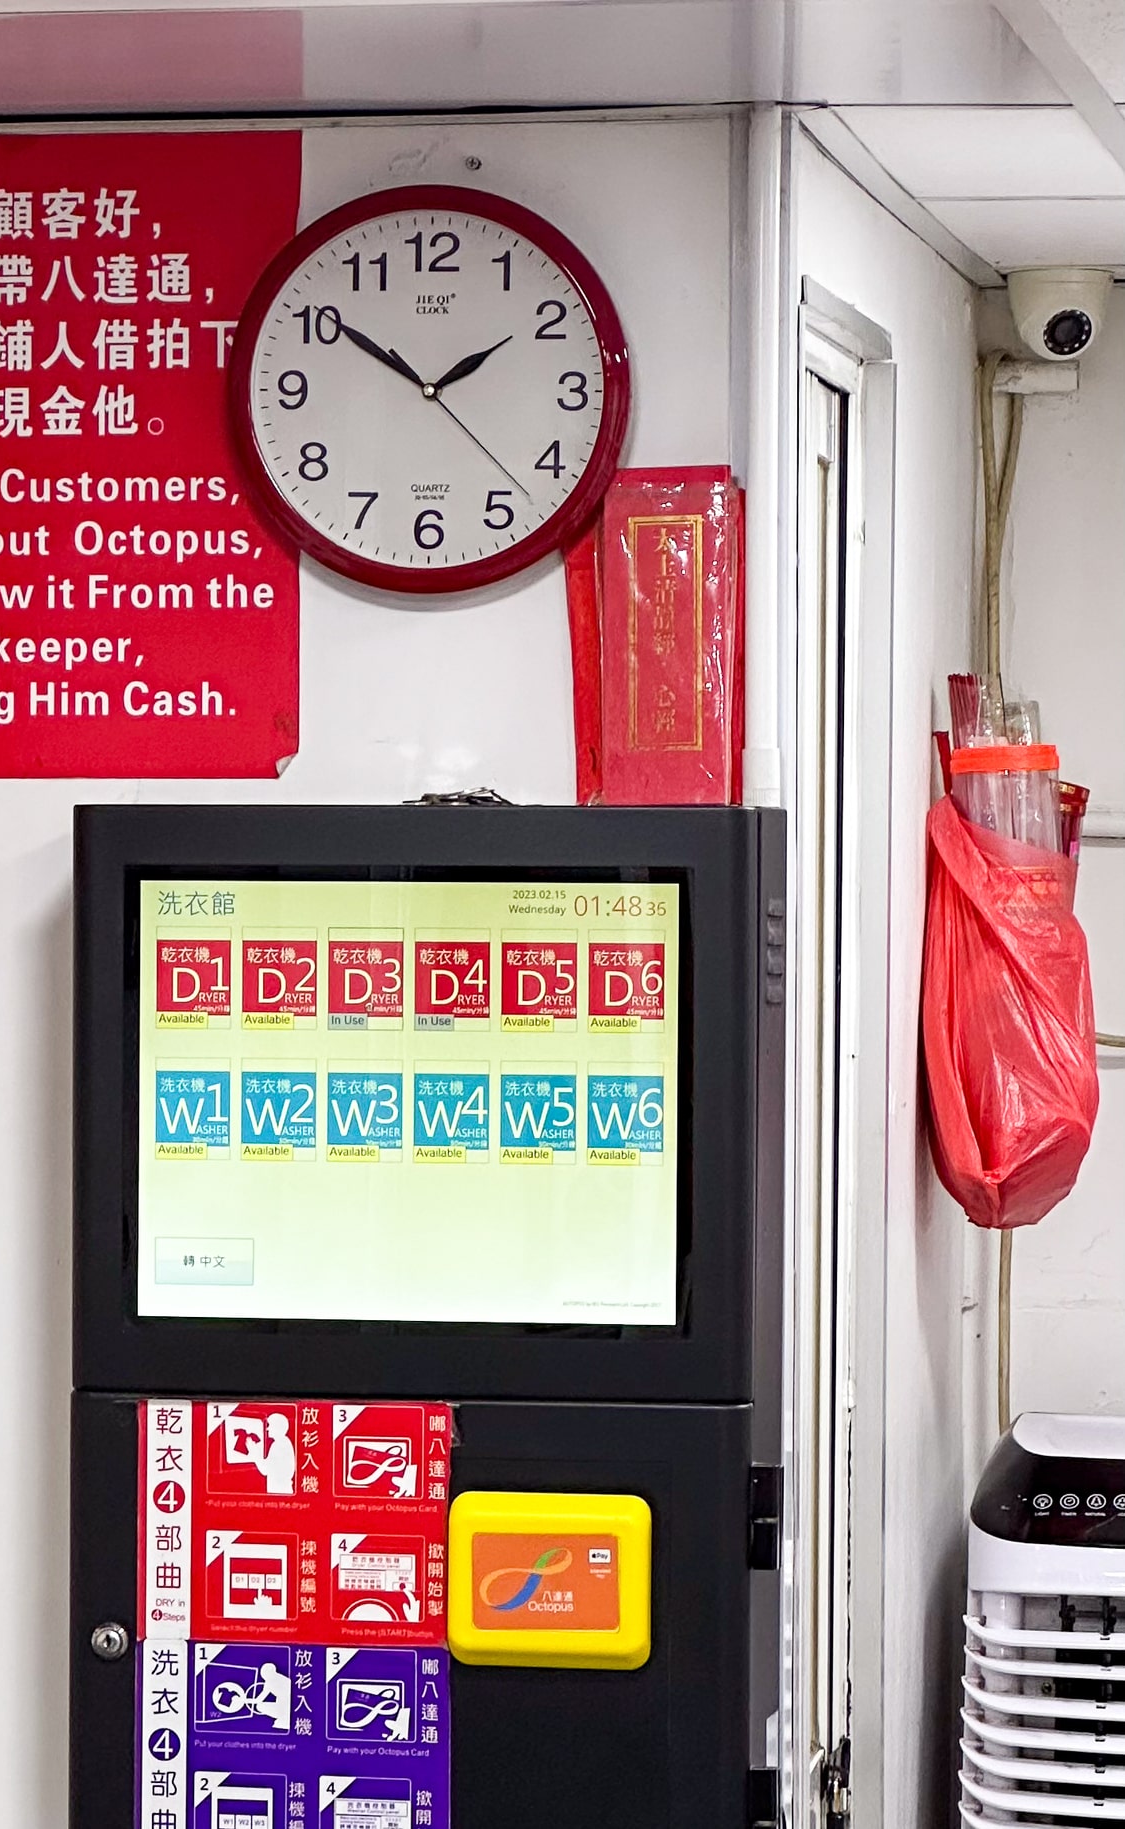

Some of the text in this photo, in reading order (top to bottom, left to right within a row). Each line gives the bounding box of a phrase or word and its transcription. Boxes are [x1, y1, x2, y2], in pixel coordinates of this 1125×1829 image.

[404, 231, 460, 272] 12
[342, 252, 387, 291] 11
[491, 251, 511, 291] 1
[416, 294, 435, 304] JIE
[416, 306, 449, 314] CLOCK
[292, 305, 341, 344] 10
[535, 300, 567, 339] 2
[277, 370, 308, 409] 9
[557, 371, 588, 410] 3
[298, 442, 328, 481] 8
[534, 440, 566, 478] 4
[0, 468, 239, 505] Customers,
[410, 484, 451, 493] QUARTZ
[348, 492, 379, 529] 7
[483, 491, 514, 529] 5
[414, 510, 444, 549] 6
[74, 521, 262, 562] Octopus,
[47, 575, 74, 609] it
[89, 575, 194, 608] From
[207, 574, 274, 608] the
[30, 682, 109, 716] Him
[123, 681, 236, 716] Cash.
[513, 890, 566, 899] 2023.02.15
[158, 890, 235, 916] 洗衣館
[509, 895, 667, 917] Wednesday 01:48 36
[161, 947, 210, 963] 乾衣機
[247, 947, 296, 964] 乾衣機
[333, 948, 382, 965] 乾衣機
[420, 949, 469, 966] 乾衣機
[507, 950, 556, 966] 乾衣機
[594, 951, 643, 967] 乾衣機
[158, 1013, 205, 1024] Available
[244, 1014, 291, 1025] Available
[331, 1015, 365, 1025] In Use
[418, 1016, 451, 1026] In Use
[504, 1016, 550, 1027] Available
[591, 1018, 637, 1028] Available
[159, 1077, 205, 1094] 洗衣機
[246, 1078, 291, 1094] 洗衣機
[332, 1079, 377, 1095] 洗衣機
[419, 1080, 464, 1096] 洗衣機
[505, 1080, 551, 1097] 洗衣機
[592, 1081, 638, 1098] 洗衣機
[158, 1145, 204, 1155] Available
[244, 1146, 289, 1156] Available
[329, 1147, 376, 1157] Available
[416, 1148, 462, 1158] Available
[503, 1149, 549, 1159] Available
[590, 1150, 636, 1160] Available
[200, 1255, 225, 1268] 中文
[213, 1405, 221, 1418] 1
[339, 1409, 347, 1422] 3
[301, 1407, 319, 1494] 放衫入機
[351, 1503, 367, 1511] with
[386, 1503, 417, 1513] Octopus
[418, 1504, 438, 1513] Card
[212, 1536, 220, 1549] 2
[338, 1539, 348, 1551] 4
[156, 1598, 185, 1607] DRY in
[528, 1601, 574, 1613] Octopus
[199, 1647, 208, 1660] 1
[332, 1652, 340, 1665] 3
[294, 1649, 312, 1736] 放衫入機
[194, 1739, 206, 1748] Put
[208, 1740, 222, 1750] your
[224, 1740, 249, 1748] clothes
[251, 1741, 263, 1749] into
[278, 1742, 296, 1751] dryer
[327, 1746, 430, 1757] Pay with your Octopus Card
[200, 1778, 209, 1790] 2
[326, 1782, 336, 1794] 4
